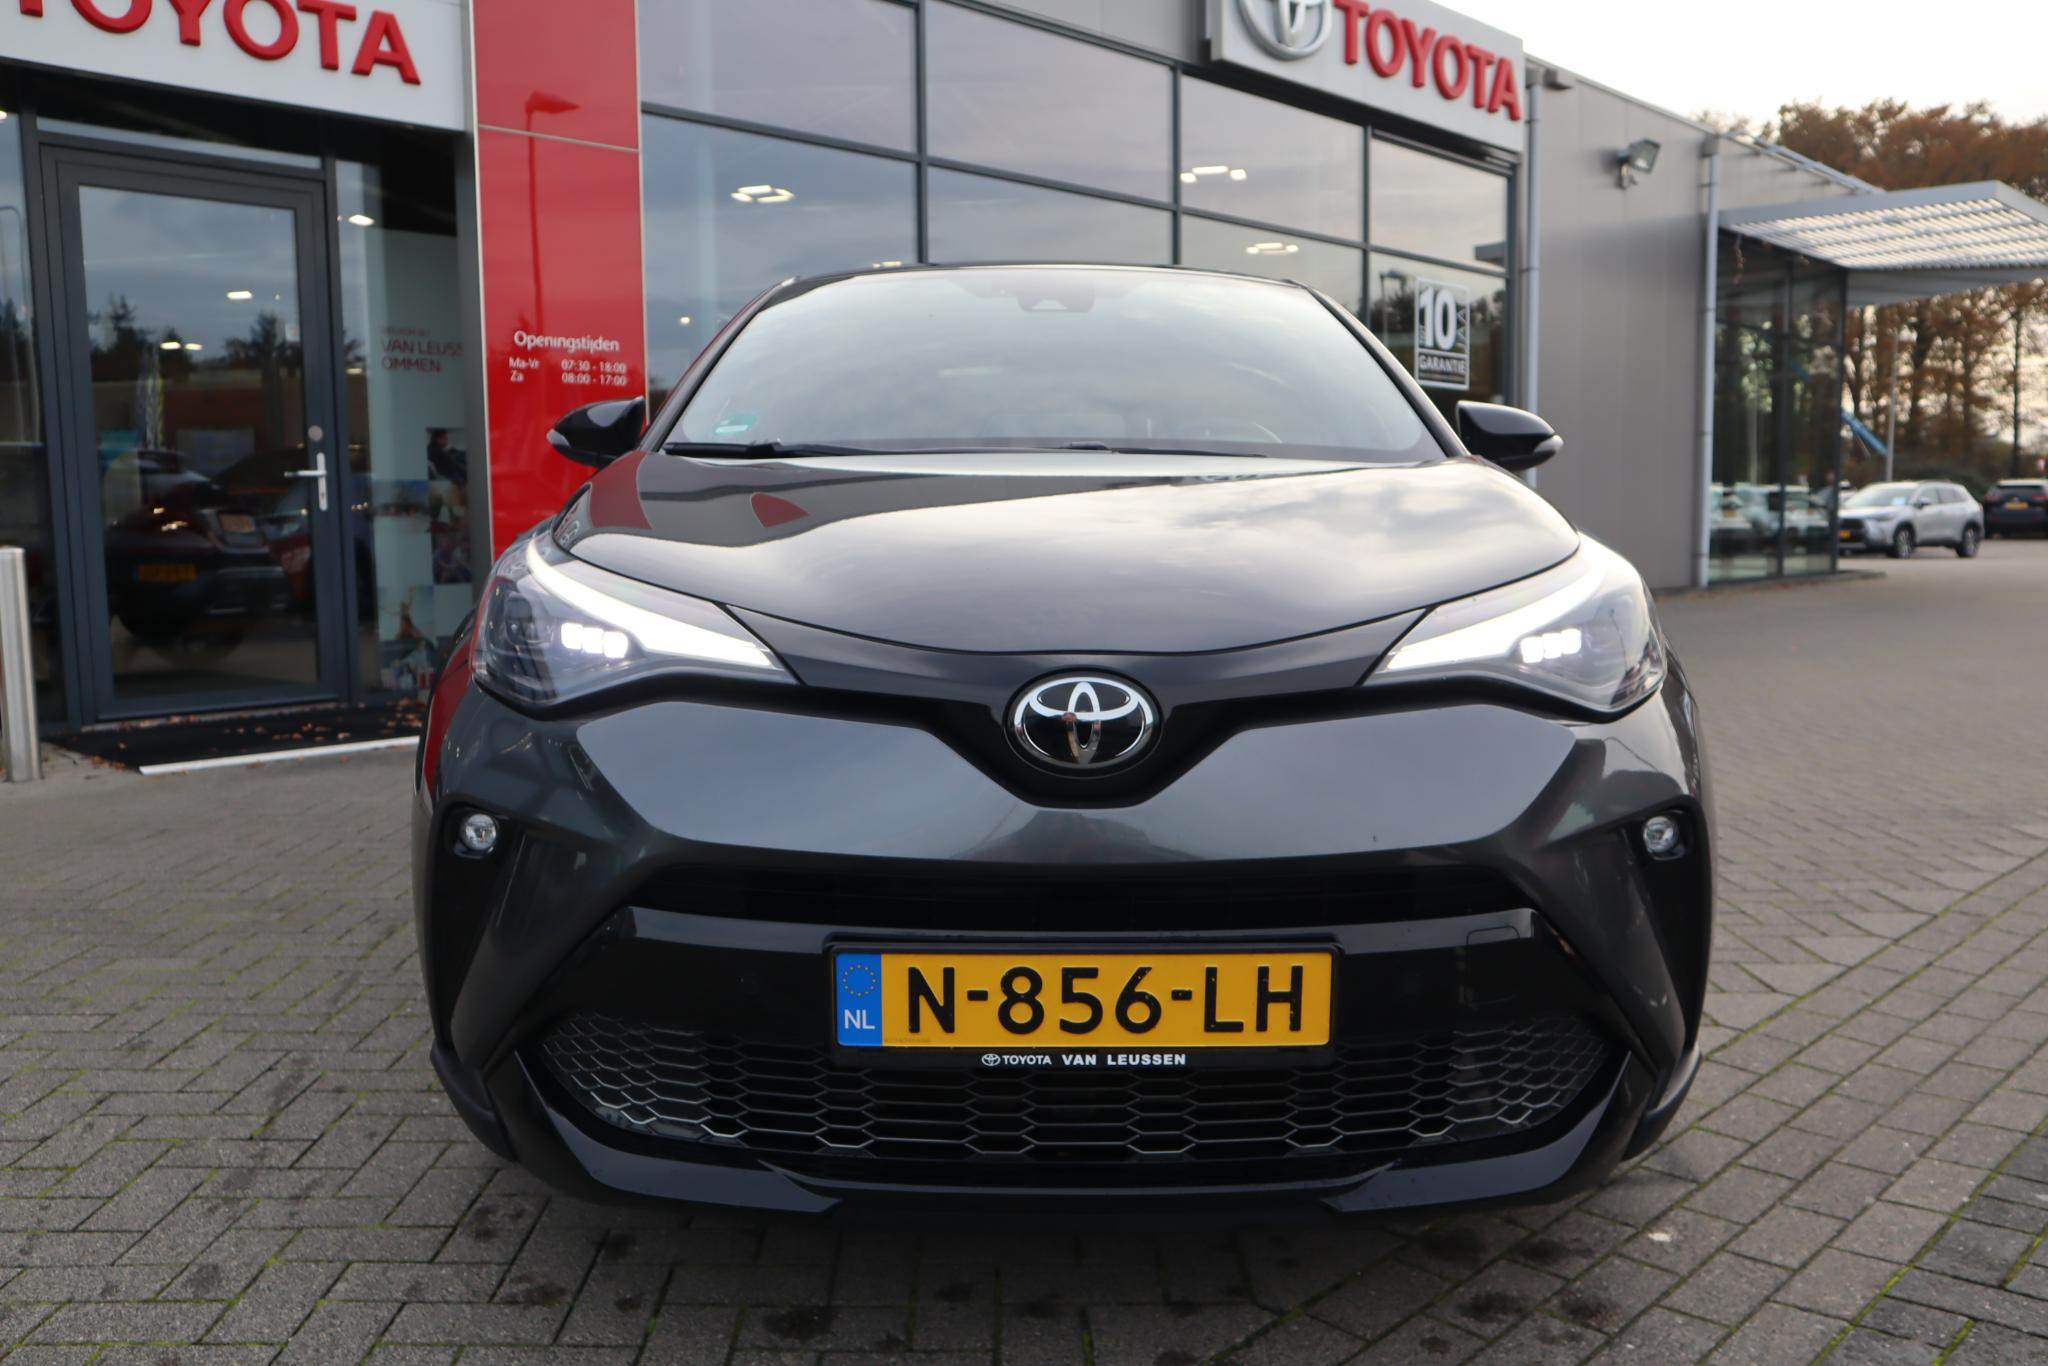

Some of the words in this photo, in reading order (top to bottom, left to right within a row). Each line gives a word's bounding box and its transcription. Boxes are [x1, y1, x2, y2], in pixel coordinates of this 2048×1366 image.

[1334, 0, 1521, 121] TOYOTA
[1420, 287, 1457, 351] 10
[514, 330, 620, 353] Openingstijden
[1420, 354, 1466, 375] GARANTIE
[511, 370, 524, 382] Za
[908, 965, 1304, 1035] N-856-LH
[844, 1009, 876, 1030] NL
[1002, 1055, 1052, 1065] TOYOTA
[1061, 1054, 1097, 1066] VAN
[1107, 1054, 1186, 1066] LEUSSEN
